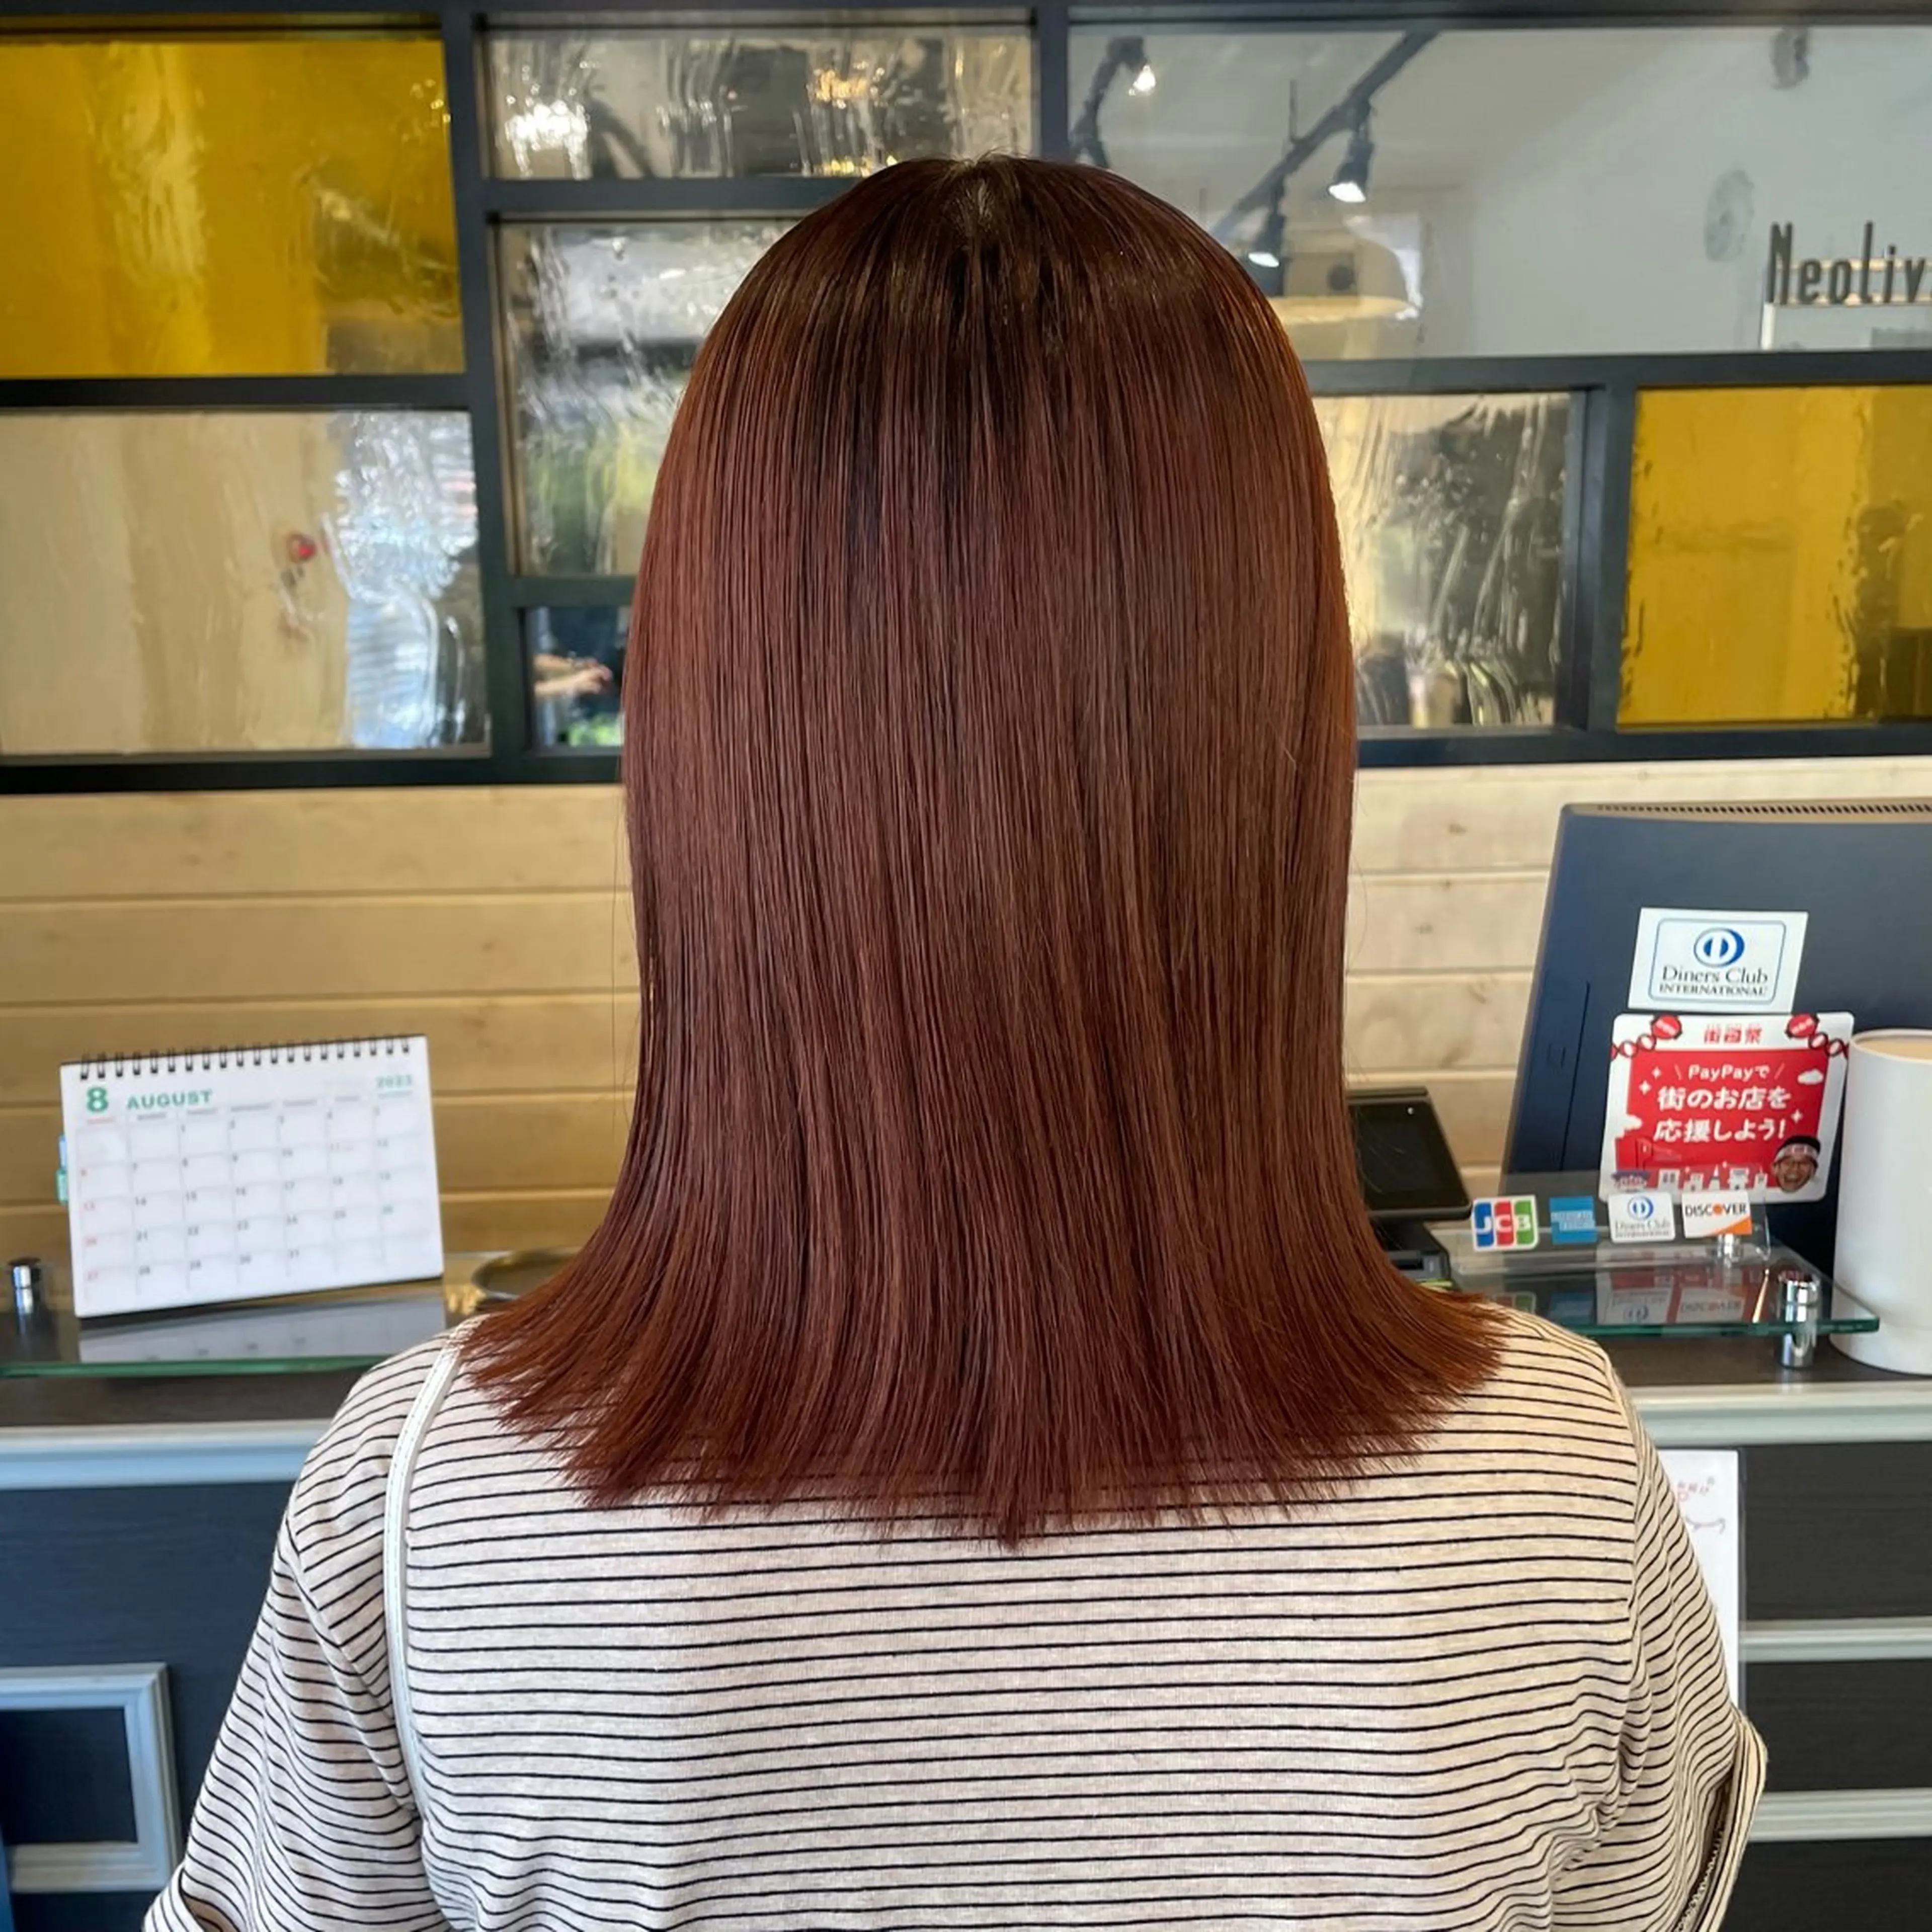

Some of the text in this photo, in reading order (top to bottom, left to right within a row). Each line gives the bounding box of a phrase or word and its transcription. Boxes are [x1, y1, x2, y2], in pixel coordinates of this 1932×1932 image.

[1766, 221, 1932, 305] Neoliv
[1662, 965, 1768, 984] Diners Club
[1660, 984, 1765, 996] INTERNATIONAL
[1688, 1063, 1770, 1082] PayPayで
[86, 1087, 109, 1112] 8
[127, 1089, 212, 1109] AUGUST
[1658, 1085, 1792, 1111] 街のお店を
[1653, 1118, 1786, 1144] 応援しよう!
[1685, 1204, 1747, 1218] DISCOVER
